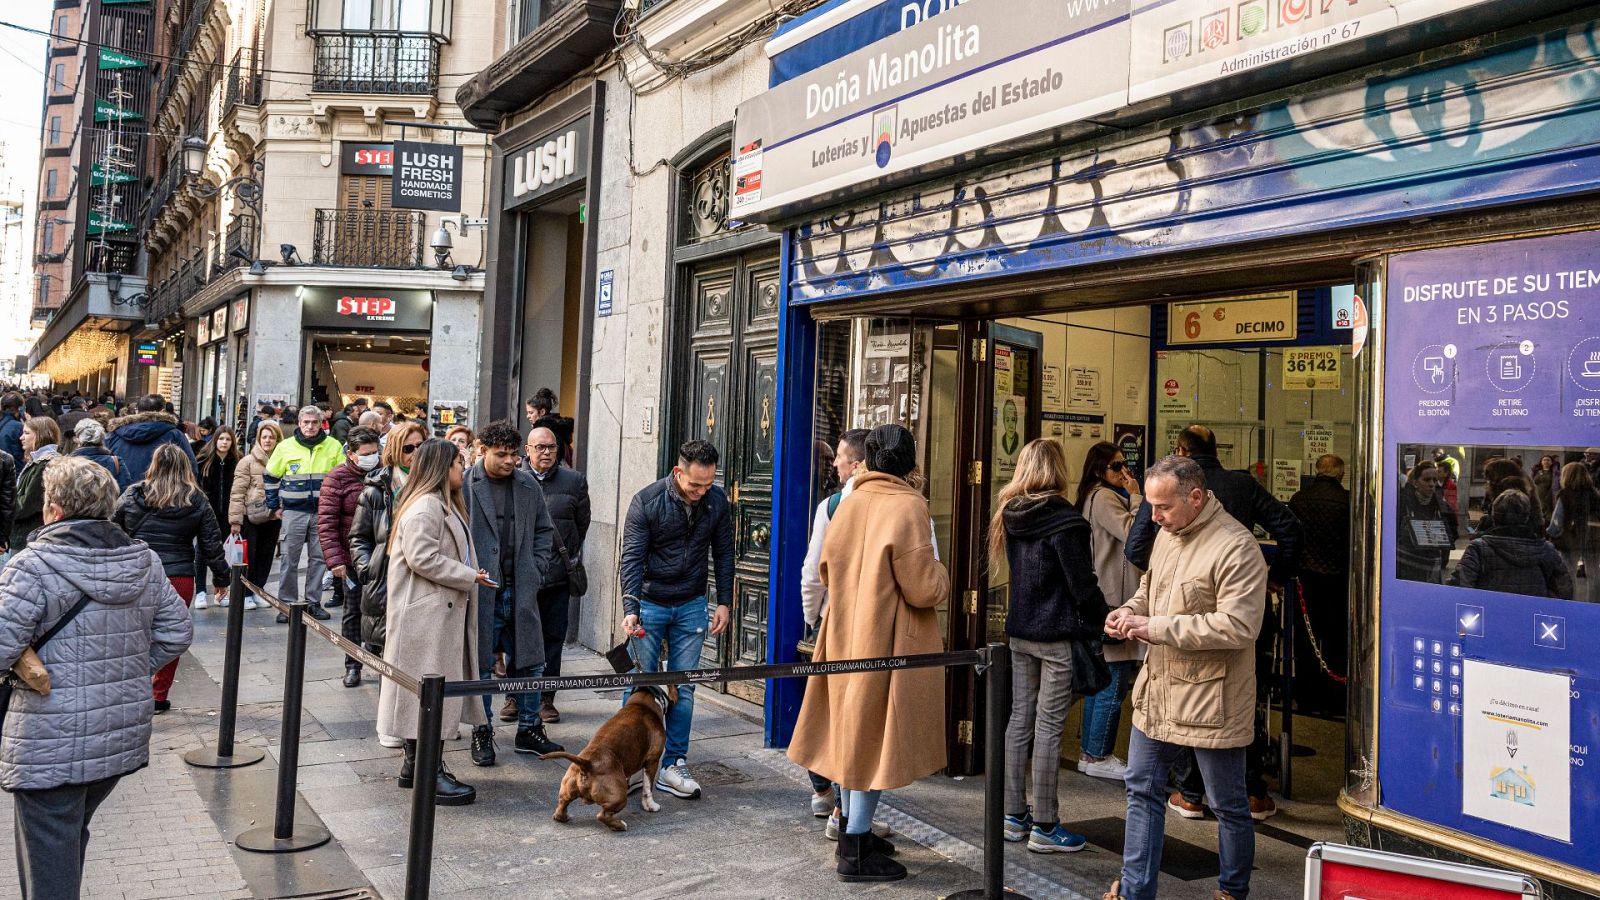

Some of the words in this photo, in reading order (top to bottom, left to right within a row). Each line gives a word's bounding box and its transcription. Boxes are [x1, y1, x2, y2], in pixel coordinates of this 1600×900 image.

[1219, 35, 1318, 75] Administración
[1341, 21, 1361, 39] 67
[806, 69, 861, 120] Doña
[866, 23, 981, 96] Manolita
[811, 137, 859, 168] Loterías
[861, 134, 869, 157] y
[899, 101, 968, 142] Apuestas
[971, 86, 997, 116] del
[1001, 67, 1064, 107] Estado
[402, 151, 454, 169] LUSH
[513, 130, 576, 197] LUSH
[401, 167, 454, 183] FRESH
[400, 180, 453, 192] HANDMADE
[400, 188, 453, 199] COSMETICS
[1403, 278, 1489, 303] DISFRUTE
[1493, 276, 1518, 295] DE
[1523, 273, 1549, 293] SU
[339, 296, 392, 315] STEP
[1457, 306, 1481, 325] EN
[1485, 305, 1498, 323] 3
[1503, 300, 1569, 322] PASOS
[1184, 311, 1201, 339] 6
[1213, 306, 1226, 321] €
[1235, 320, 1285, 334] DECIMO
[1297, 351, 1334, 360] PREMIO
[1524, 344, 1530, 352] 2
[1286, 358, 1337, 372] 36142
[1418, 399, 1451, 407] PRESIONE
[1498, 398, 1523, 407] RETIRE
[1418, 408, 1426, 416] EL
[1491, 408, 1503, 416] SU
[1503, 408, 1529, 416] TURNO
[1573, 408, 1584, 417] SU
[792, 658, 907, 675] WWW.LOTERIAMANOLITA.COM
[498, 676, 633, 692] WWW.LOTERIAMANOLITA.COM
[1481, 710, 1549, 727] www.loteriamanolita.com
